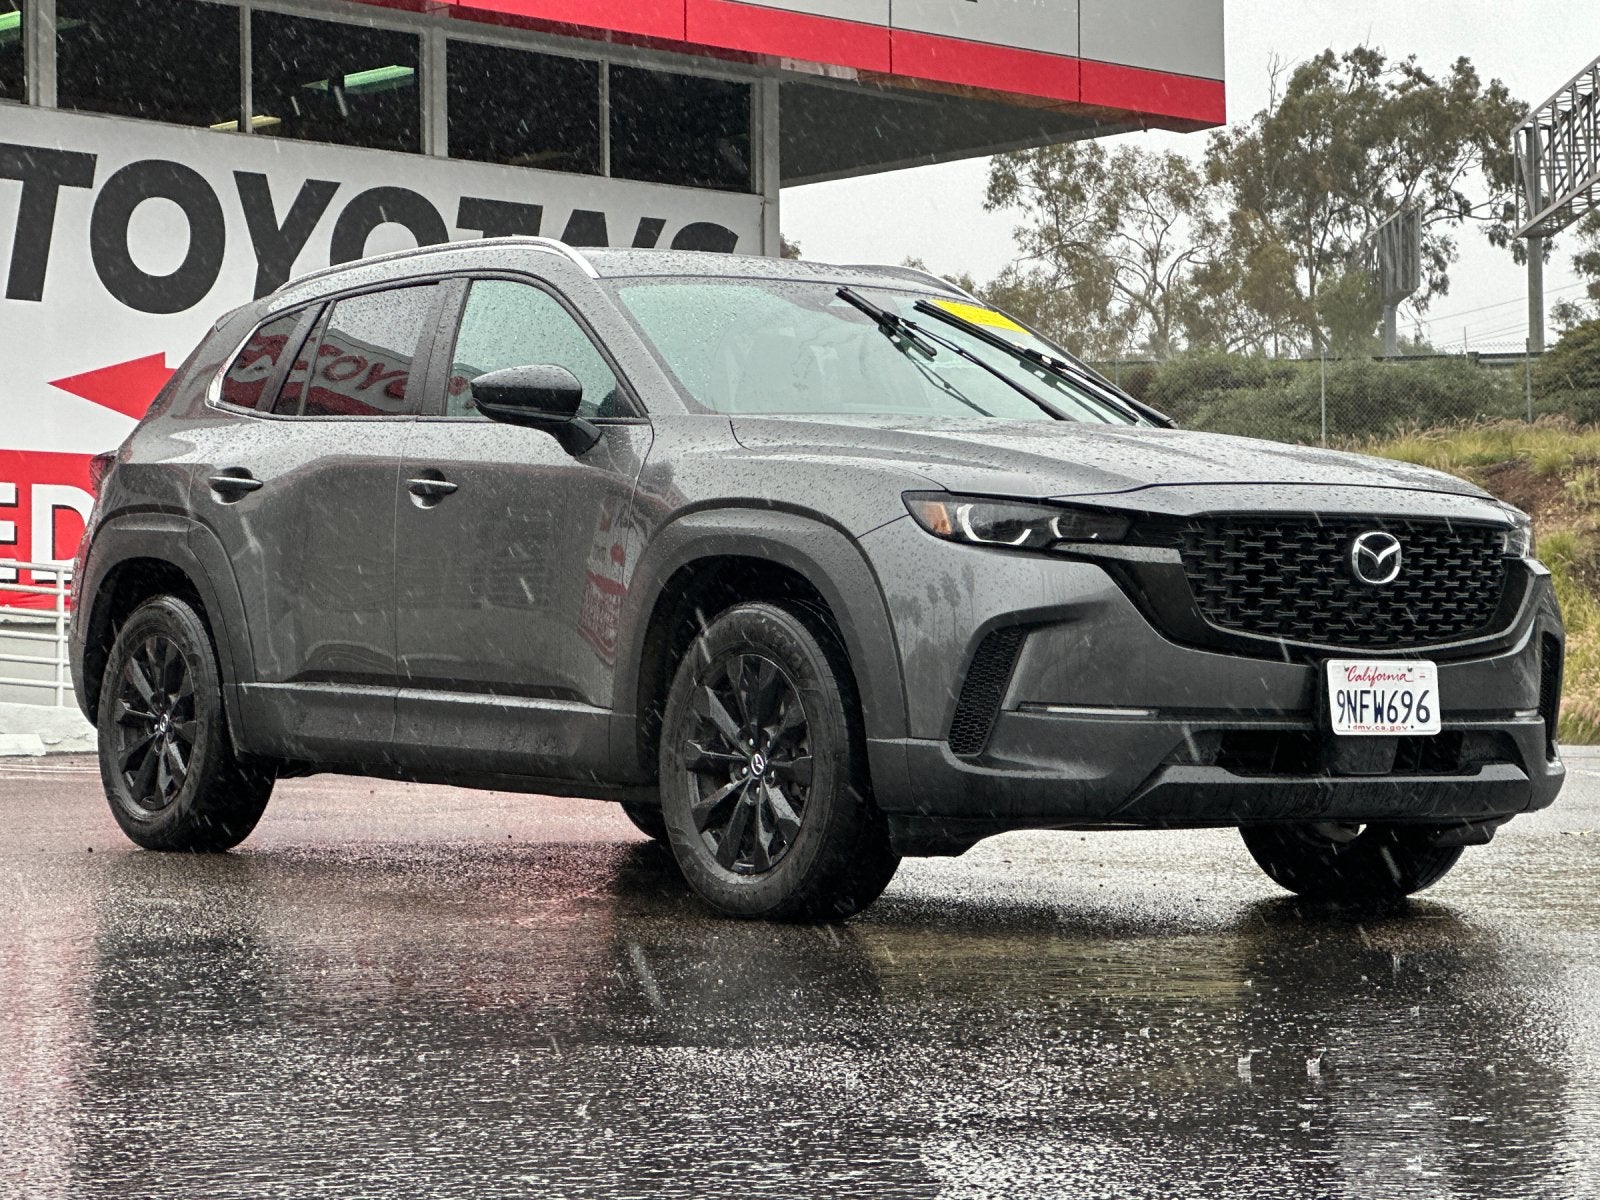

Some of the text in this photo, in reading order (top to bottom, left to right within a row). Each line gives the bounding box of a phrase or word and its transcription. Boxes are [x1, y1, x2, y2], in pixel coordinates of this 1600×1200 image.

[0, 143, 739, 313] TOYOT'
[1346, 665, 1414, 687] California
[1336, 689, 1431, 724] 9NFW696
[1353, 724, 1408, 732] dmv.ca.gov
